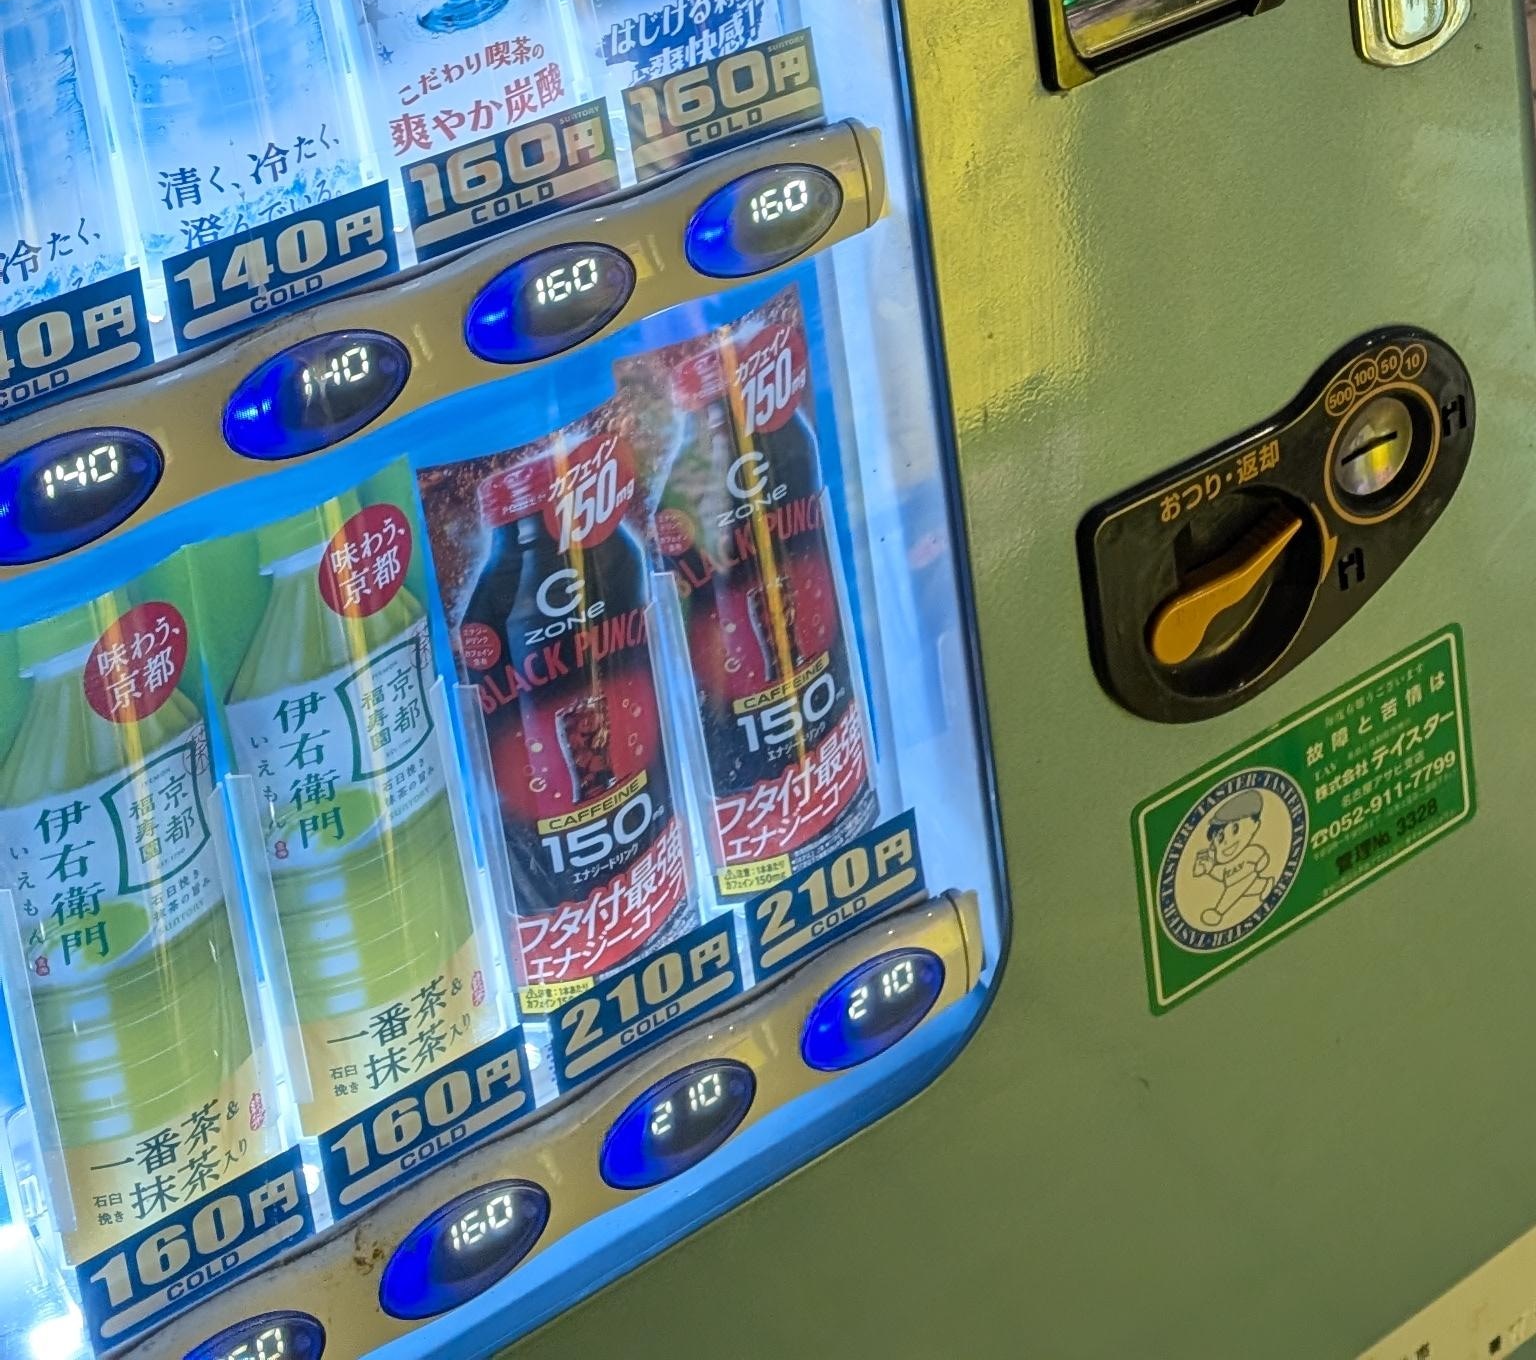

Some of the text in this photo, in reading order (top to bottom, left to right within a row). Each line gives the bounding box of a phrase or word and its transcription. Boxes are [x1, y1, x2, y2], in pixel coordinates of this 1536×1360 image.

[398, 35, 545, 107] こだわり喫茶の
[629, 44, 811, 138] 160円
[389, 62, 566, 157] 爽やか炭酸
[686, 109, 763, 147] COLD
[410, 120, 607, 217] 160円
[471, 182, 555, 225] COLD
[750, 179, 808, 225] 160
[174, 206, 385, 310] 140円
[535, 257, 599, 306] 160
[249, 274, 323, 315] COLD
[301, 346, 370, 396] 140
[733, 326, 791, 386] カフェイン
[1328, 352, 1421, 408] 500 100 50 10
[43, 444, 119, 499] 140
[547, 435, 619, 503] カフェイン
[1159, 439, 1281, 523] おつり・返却
[554, 458, 634, 555] 150mg
[332, 517, 405, 573] 味わう、
[338, 548, 401, 610] 京都
[97, 615, 181, 679] 味わう、
[106, 646, 175, 715] 京都
[386, 666, 422, 735] 京都
[743, 661, 825, 709] CAFFEINE
[1305, 670, 1446, 769] 故障と苦情は
[273, 691, 345, 850] 伊右衛門
[1327, 751, 1456, 843] 052-911-7799
[128, 795, 163, 865] 福寿園
[157, 776, 197, 845] 京都
[548, 777, 641, 832] CAFFEINE
[1396, 798, 1440, 838] 3328
[9, 844, 45, 945] いえもん
[34, 800, 109, 967] 伊右衛門
[571, 843, 640, 885] エナジードリンク
[756, 828, 913, 946] 210円
[810, 896, 868, 938] COLD
[560, 930, 730, 1057] 210円
[848, 960, 915, 1021] 210
[366, 1014, 472, 1091] 抹茶入り
[619, 1001, 681, 1047] COLD
[331, 1046, 521, 1177] 160円
[333, 1082, 360, 1097] 挽き
[650, 1072, 721, 1137] 210
[131, 1137, 248, 1220] 抹茶入り
[399, 1124, 467, 1170] COLD
[90, 1169, 299, 1309] 160円
[97, 1210, 124, 1226] 挽き
[450, 1194, 514, 1252] 160
[167, 1251, 240, 1302] COLD
